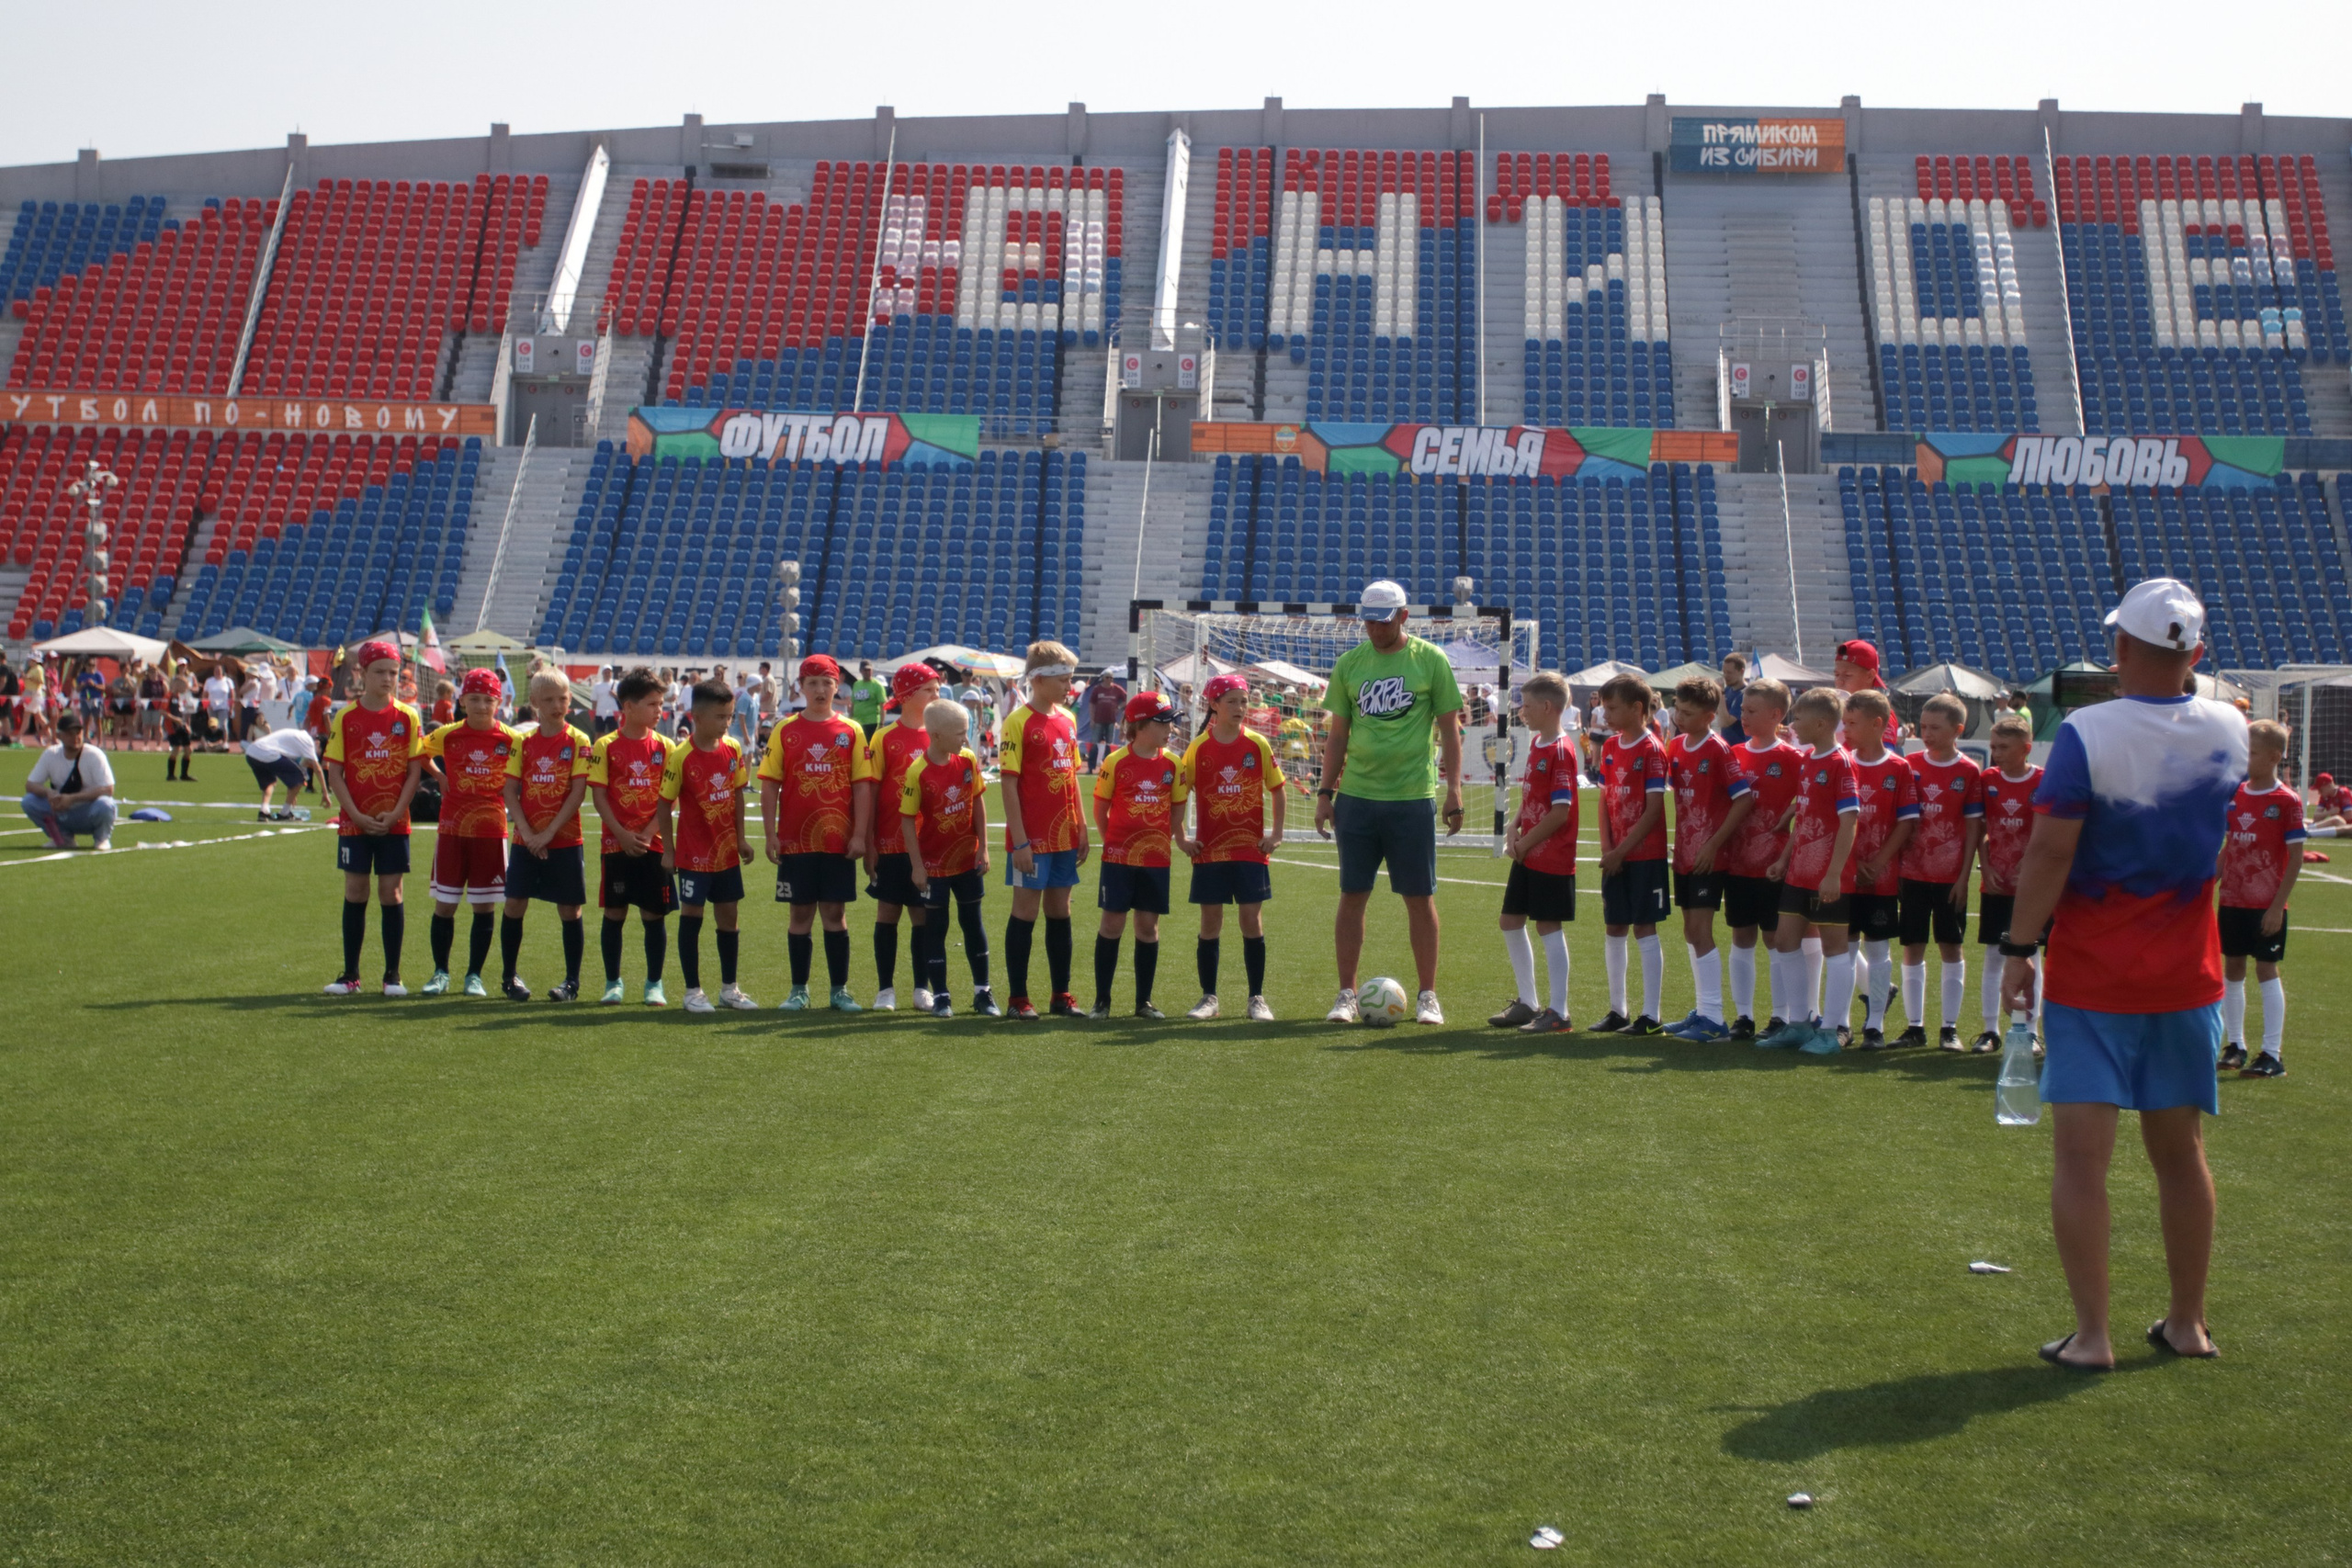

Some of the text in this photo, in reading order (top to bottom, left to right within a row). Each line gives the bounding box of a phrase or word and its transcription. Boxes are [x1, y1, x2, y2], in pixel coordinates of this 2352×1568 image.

[1702, 123, 1817, 144] ПРЯМИКОМ
[1701, 147, 1817, 166] ИЗ СИБИРИ
[8, 393, 158, 423] УТБОЛ
[719, 412, 889, 465] ФУТБОЛ
[1410, 425, 1546, 479] СЕМЬЯ
[2008, 435, 2188, 488] ЛЮБОВЬ
[1359, 676, 1406, 700] COPA
[366, 750, 390, 760] КНП
[805, 762, 831, 773] КНП
[1053, 759, 1073, 770] КНП
[532, 773, 555, 784] КНП
[629, 777, 650, 787] КНП
[709, 789, 730, 802] КНП
[1217, 784, 1241, 795] КНП
[944, 801, 966, 816] КНП
[1919, 802, 1942, 813] КНП
[1999, 818, 2023, 827] КНП
[2233, 831, 2256, 842] КНП
[776, 881, 793, 898] 23
[1652, 887, 1663, 909] 7
